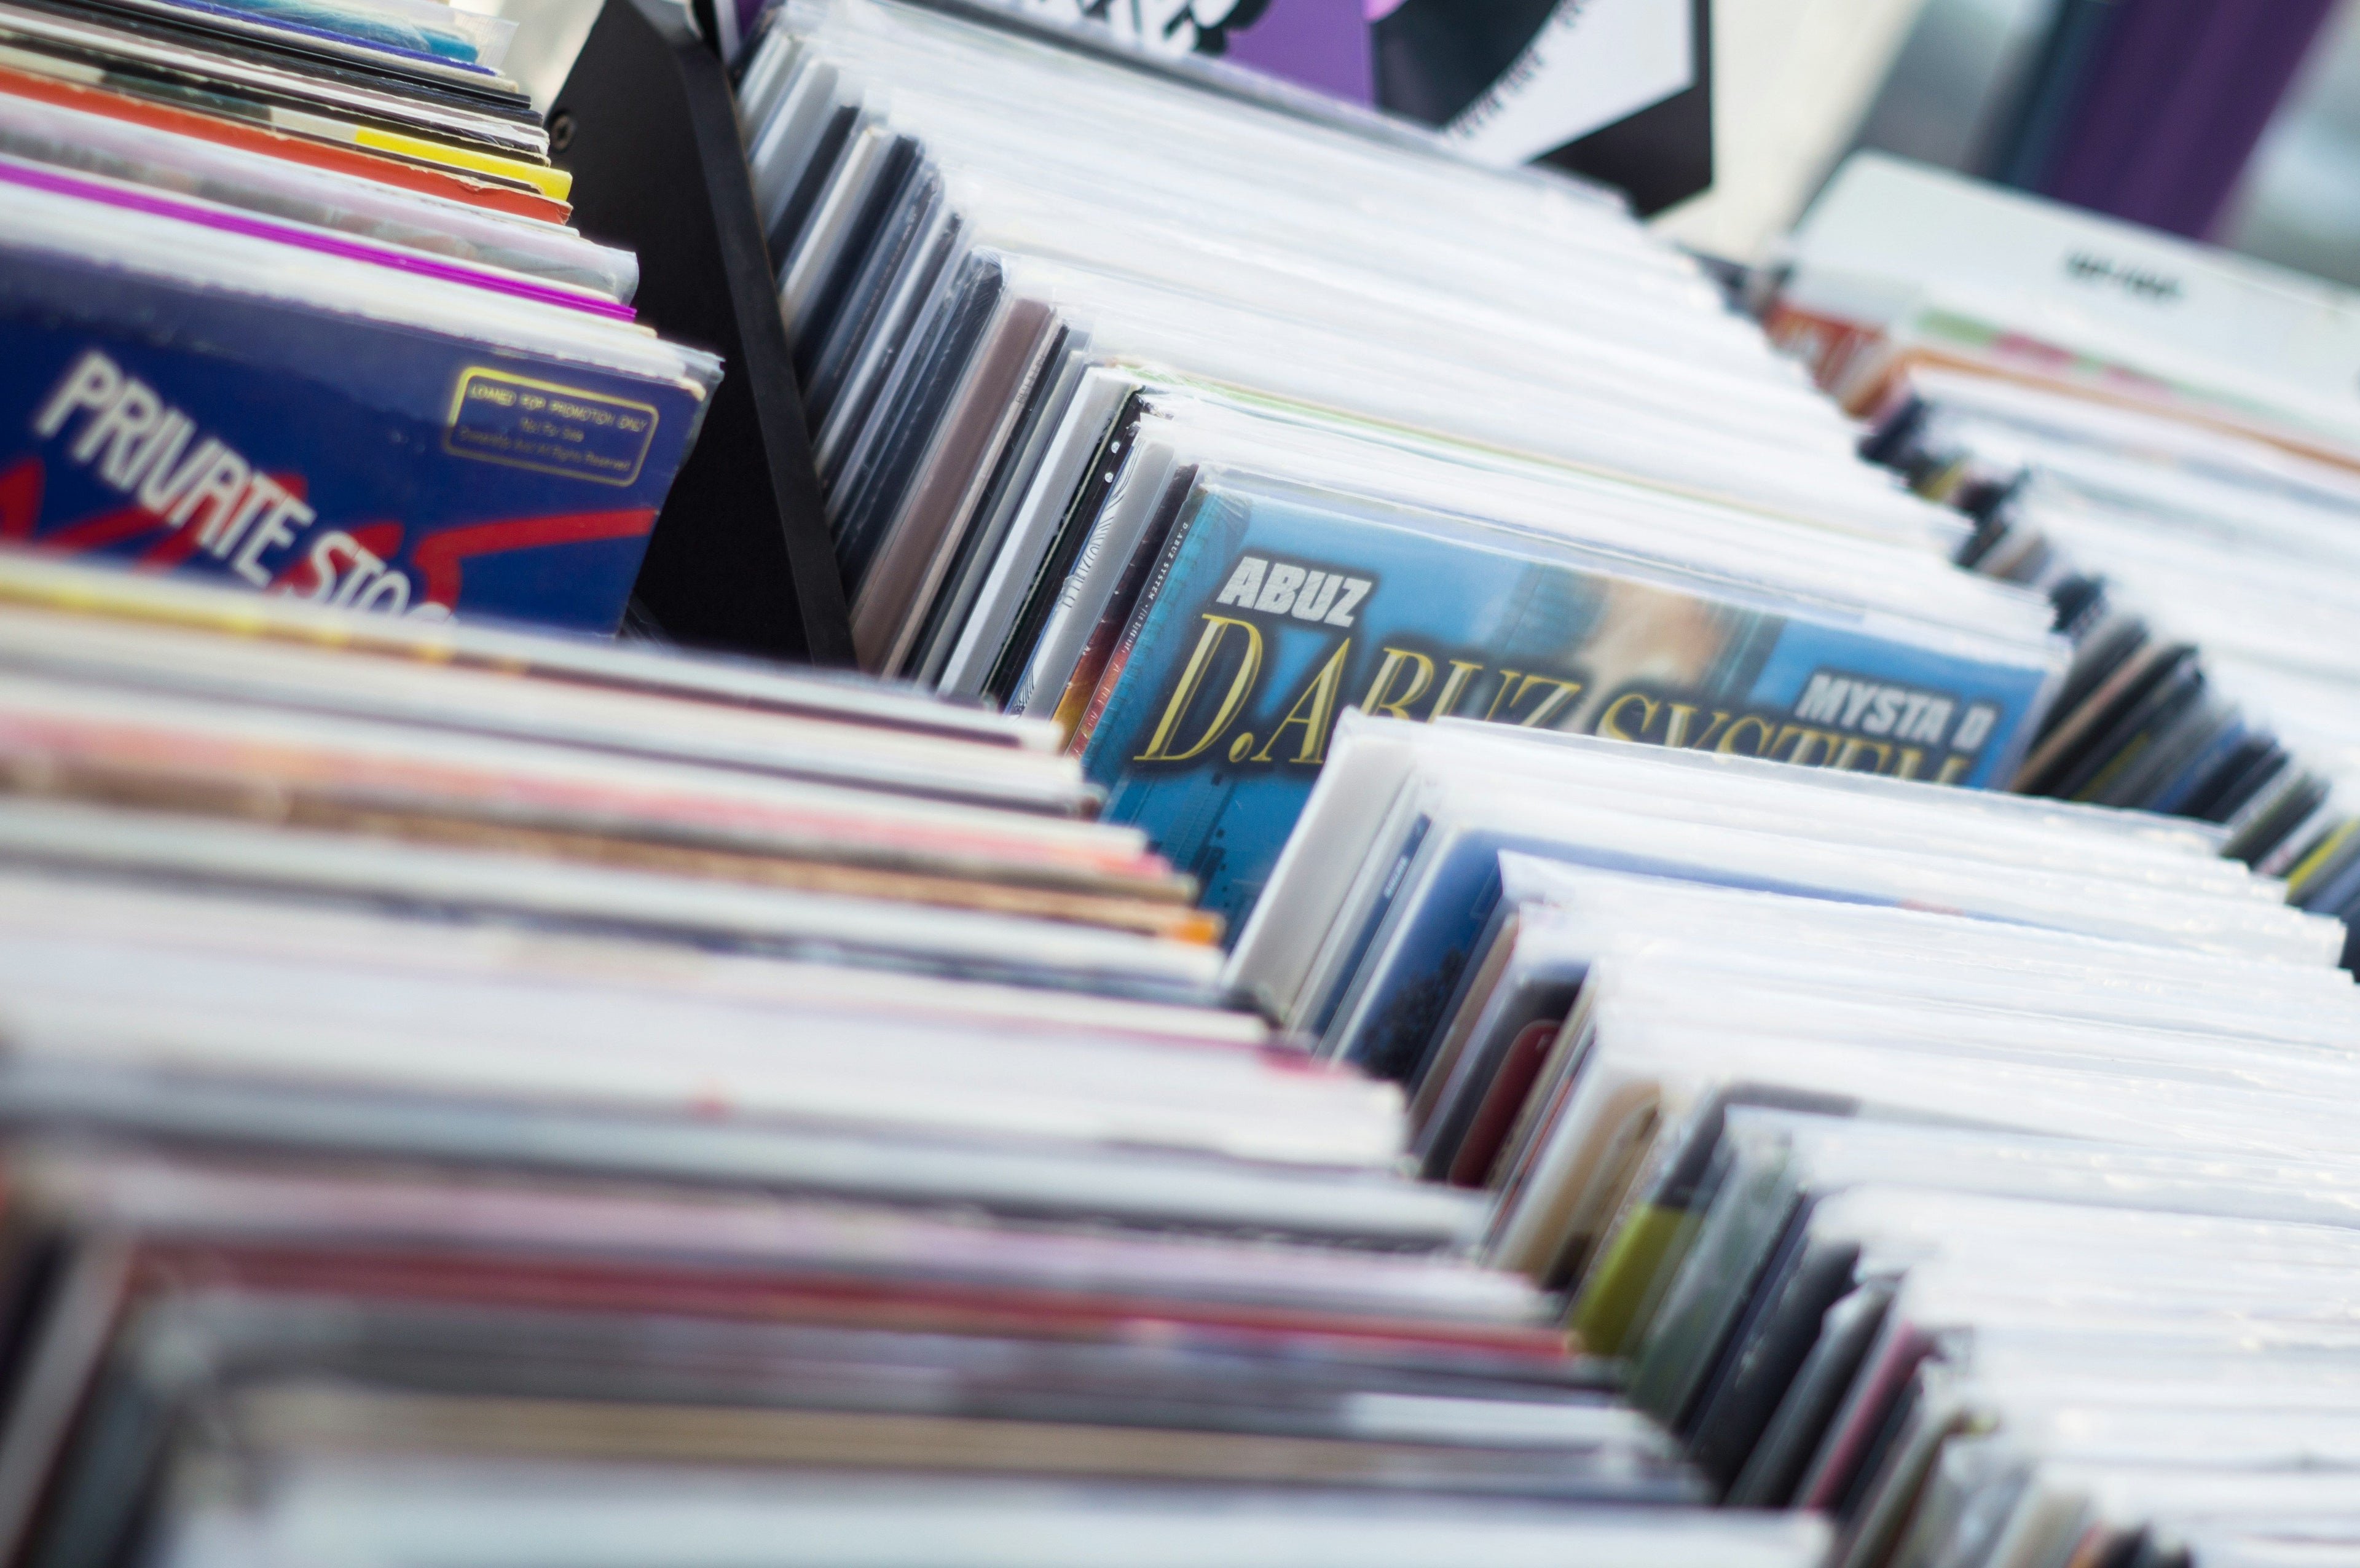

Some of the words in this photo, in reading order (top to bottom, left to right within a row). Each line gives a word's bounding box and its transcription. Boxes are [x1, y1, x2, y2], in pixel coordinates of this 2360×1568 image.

[549, 400, 615, 425] PROMOTION
[617, 414, 648, 433] ONLY
[36, 350, 317, 588] PRIVATE
[310, 530, 455, 618] STO
[1168, 522, 1189, 560] D.ABUZ
[1148, 562, 1170, 600] SYSTEM
[1216, 555, 1374, 628] ABUZ
[1794, 673, 1954, 743] MYSTA
[1952, 704, 1997, 752] D
